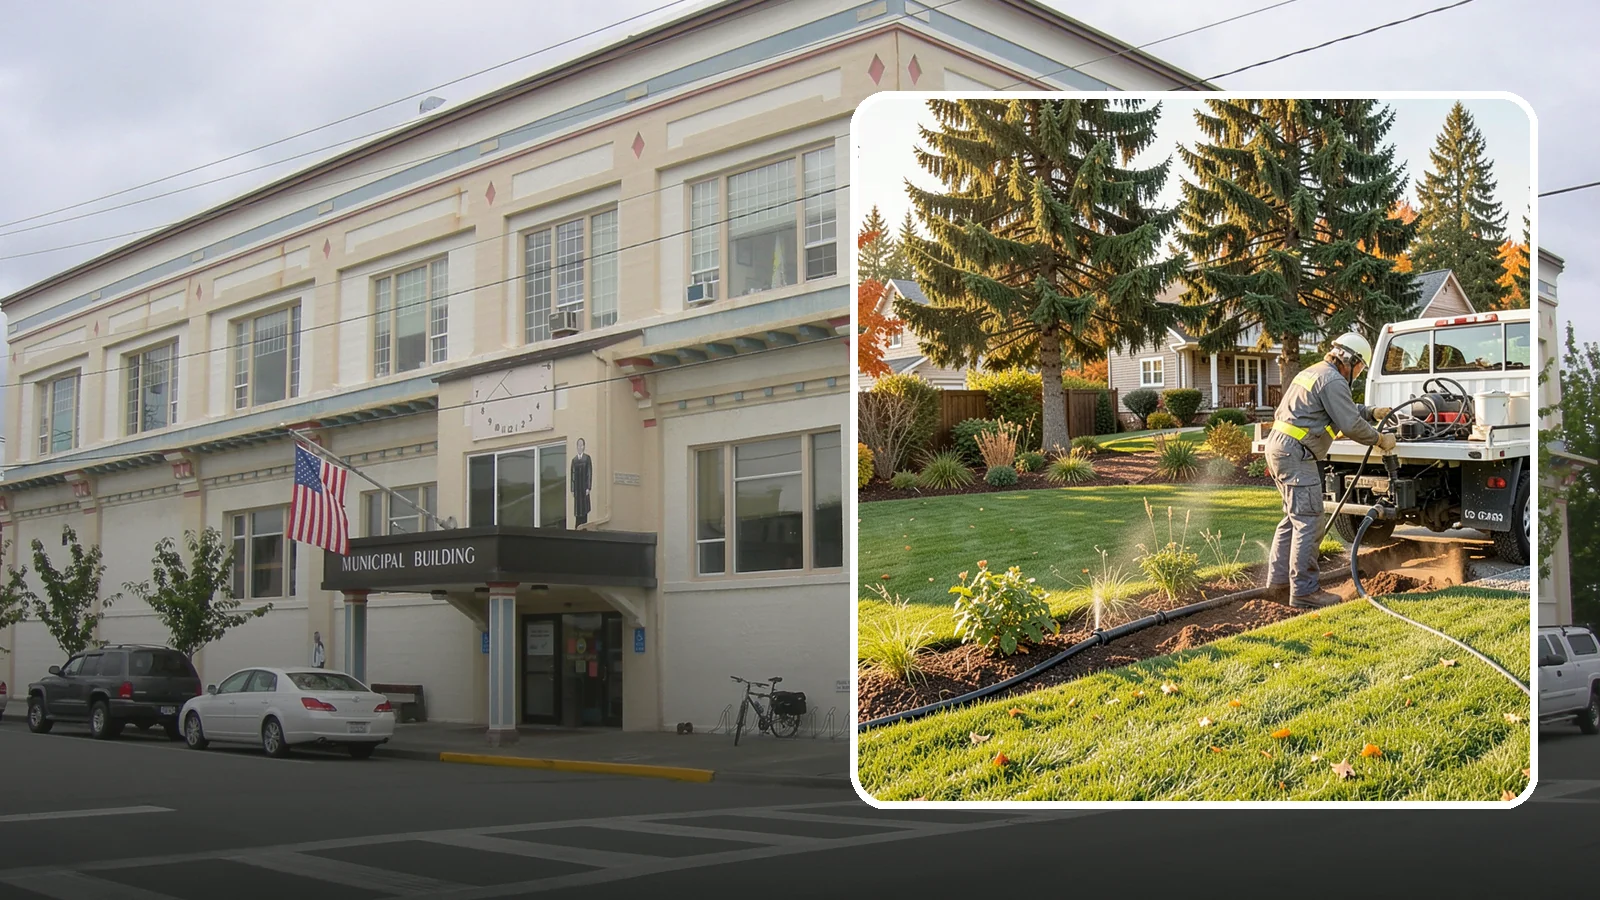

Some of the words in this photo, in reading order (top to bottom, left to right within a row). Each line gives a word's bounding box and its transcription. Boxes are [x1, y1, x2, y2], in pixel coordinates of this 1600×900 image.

[475, 390, 479, 398] 7
[481, 407, 485, 415] 8
[488, 418, 492, 426] 9
[495, 424, 500, 432] 10
[502, 426, 506, 434] 11
[529, 414, 533, 422] 3
[536, 403, 540, 411] 4
[342, 553, 405, 572] MUNICIPAL
[414, 546, 475, 566] BUILDING
